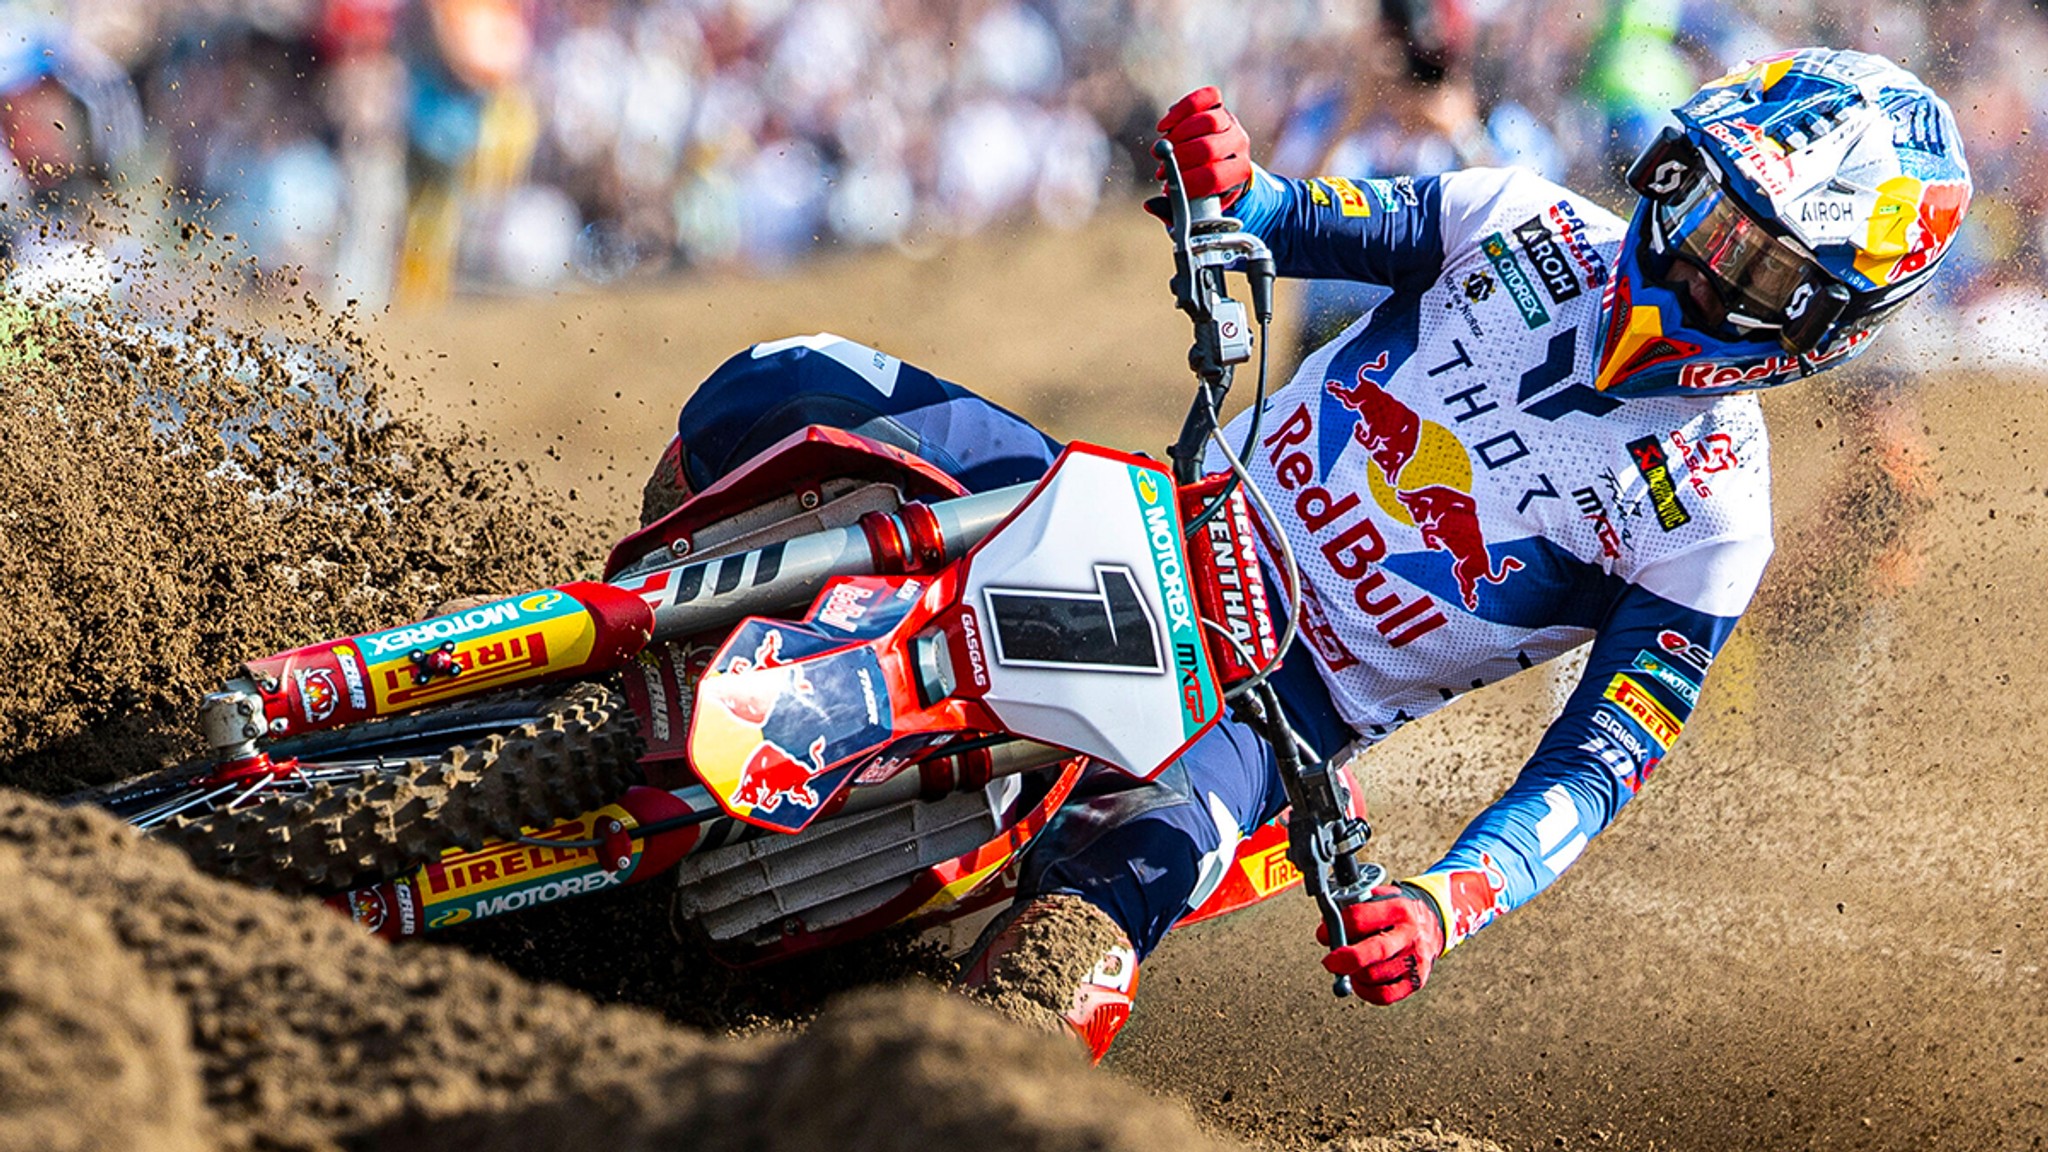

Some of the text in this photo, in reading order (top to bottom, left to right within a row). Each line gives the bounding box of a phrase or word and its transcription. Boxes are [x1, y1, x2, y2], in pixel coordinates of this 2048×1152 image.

[1557, 199, 1609, 286] PARTS
[1801, 202, 1854, 222] AIROH
[1498, 257, 1541, 320] OTOREX
[1520, 228, 1576, 296] AROH
[1678, 356, 1779, 390] Red
[1427, 338, 1560, 515] THOR
[1263, 402, 1361, 534] Red
[1320, 518, 1448, 649] Bull
[1145, 506, 1192, 633] MOTOREX
[366, 602, 520, 655] MOTOREX
[961, 613, 986, 687] GASGAS
[982, 563, 1165, 676] 1
[1176, 643, 1205, 723] MXGP
[476, 869, 622, 918] MOTOREX
